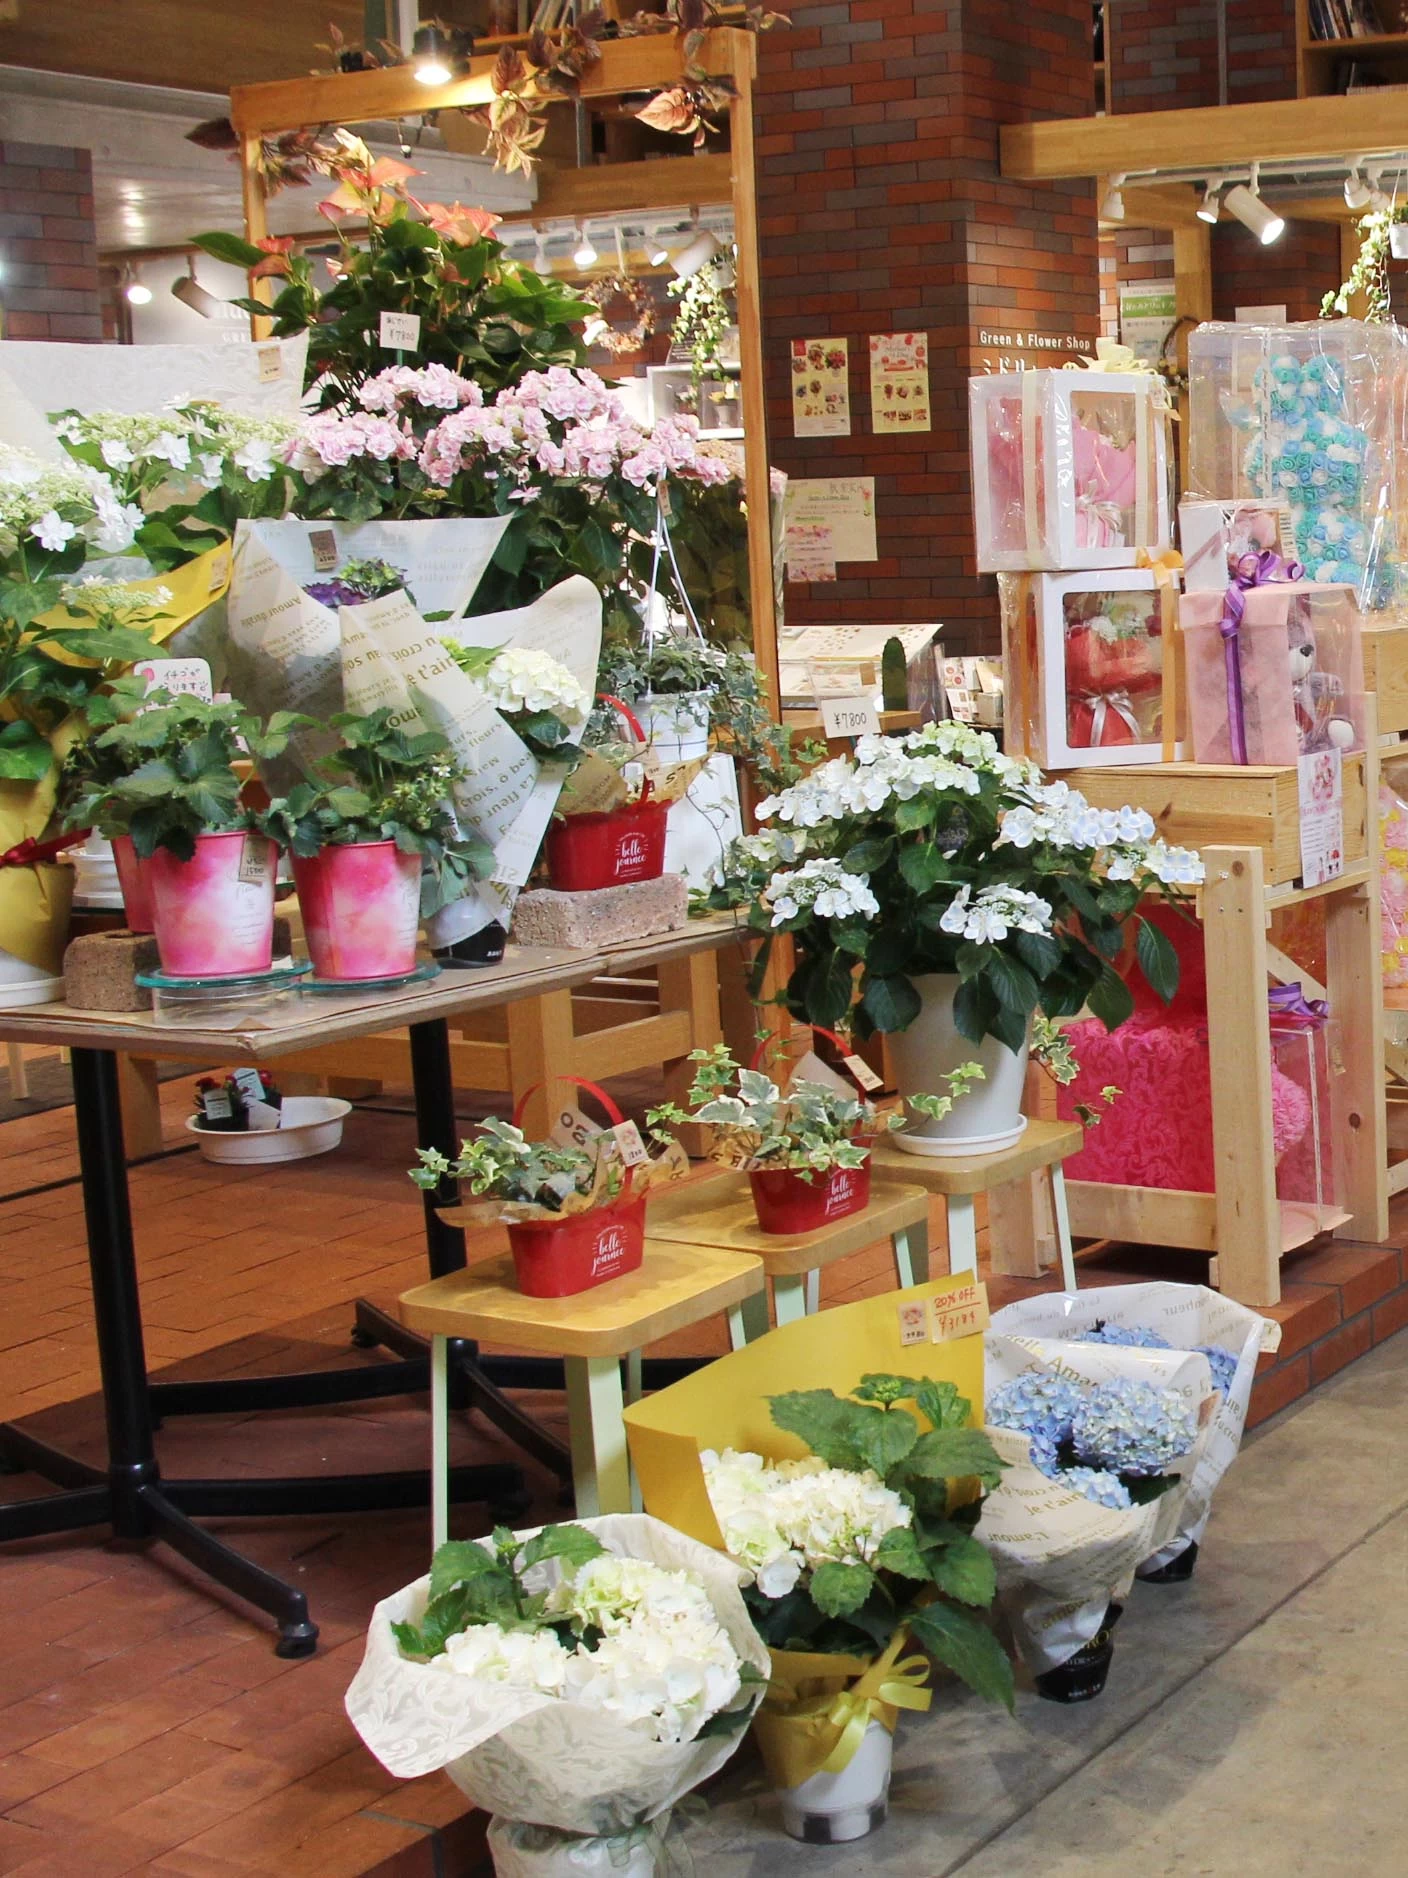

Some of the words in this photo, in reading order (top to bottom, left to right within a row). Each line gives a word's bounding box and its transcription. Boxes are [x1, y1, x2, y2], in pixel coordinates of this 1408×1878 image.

[980, 330, 1012, 345] Green
[1016, 333, 1024, 346] &
[1027, 333, 1062, 348] Flower
[1066, 336, 1091, 351] Shop
[833, 712, 867, 729] ¥7800
